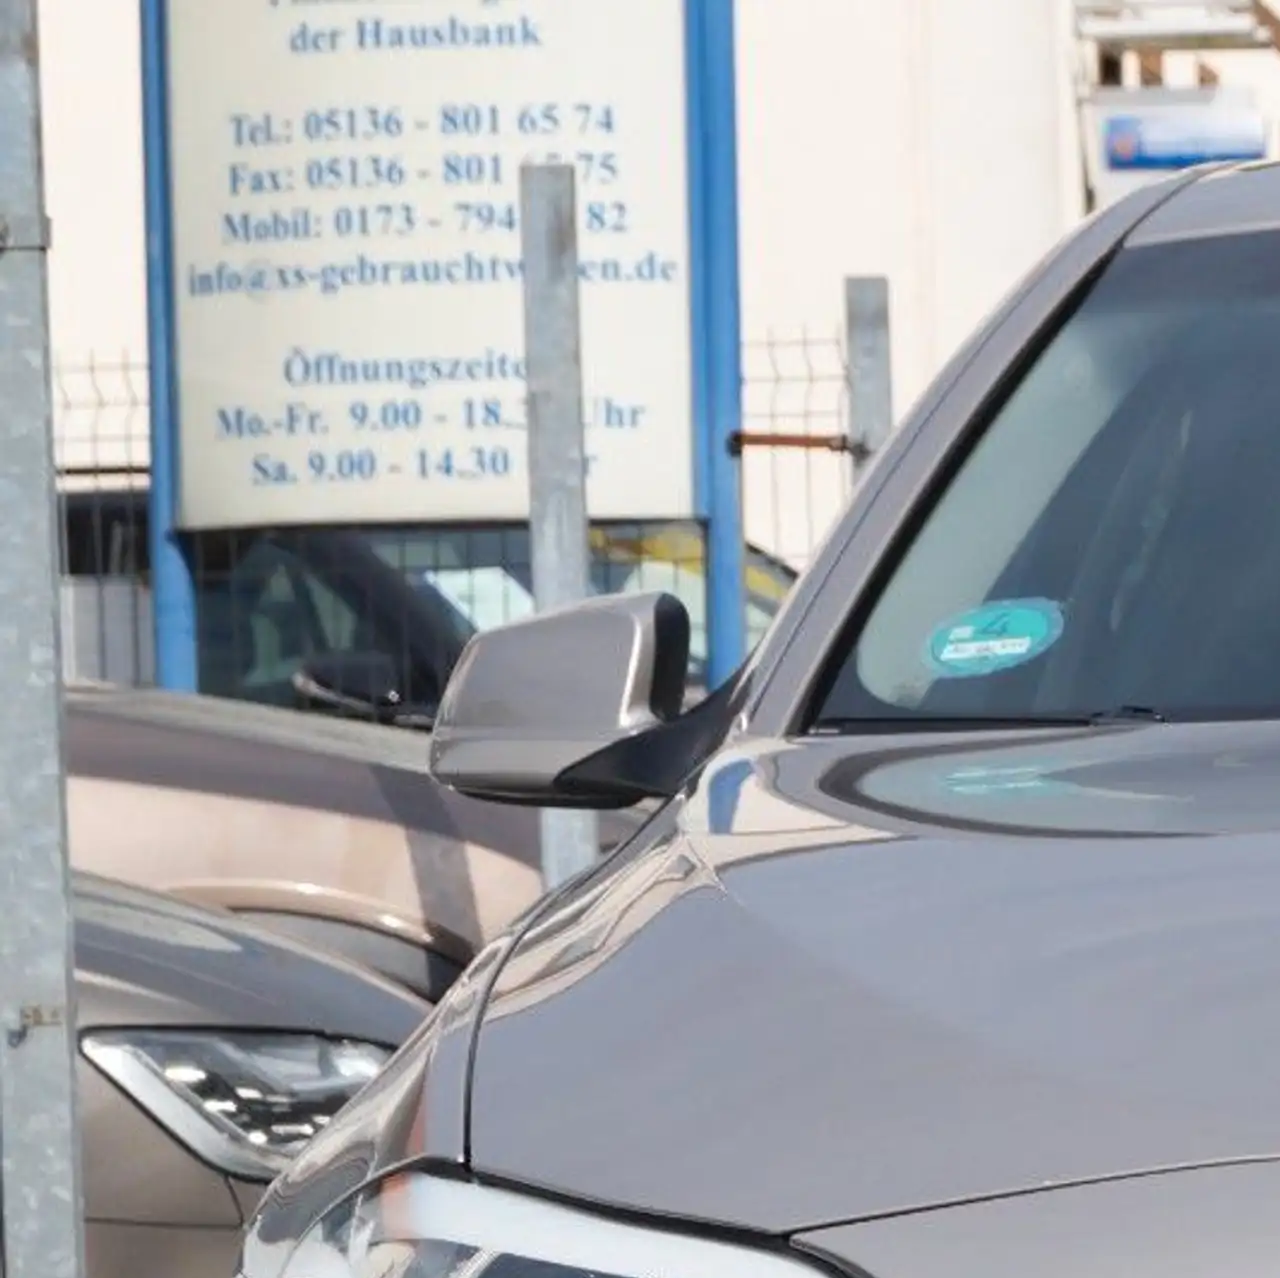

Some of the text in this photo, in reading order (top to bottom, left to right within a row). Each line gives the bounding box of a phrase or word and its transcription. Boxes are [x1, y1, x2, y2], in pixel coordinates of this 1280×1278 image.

[290, 17, 541, 52] der Hausbank
[304, 107, 403, 142] 05136
[441, 104, 499, 134] 801
[517, 104, 560, 133] 65
[575, 104, 613, 132] 74
[228, 163, 294, 195] Fax:
[307, 156, 404, 189] 05136
[443, 153, 501, 184] 801
[577, 152, 617, 184] 75
[222, 207, 322, 243] Mobil:
[334, 204, 416, 237] 0173
[454, 202, 516, 232] 794
[586, 202, 627, 231] 82
[349, 401, 422, 430] 9.00
[251, 454, 298, 486] Sa.
[308, 450, 377, 479] 9.00
[417, 447, 510, 478] 14.30
